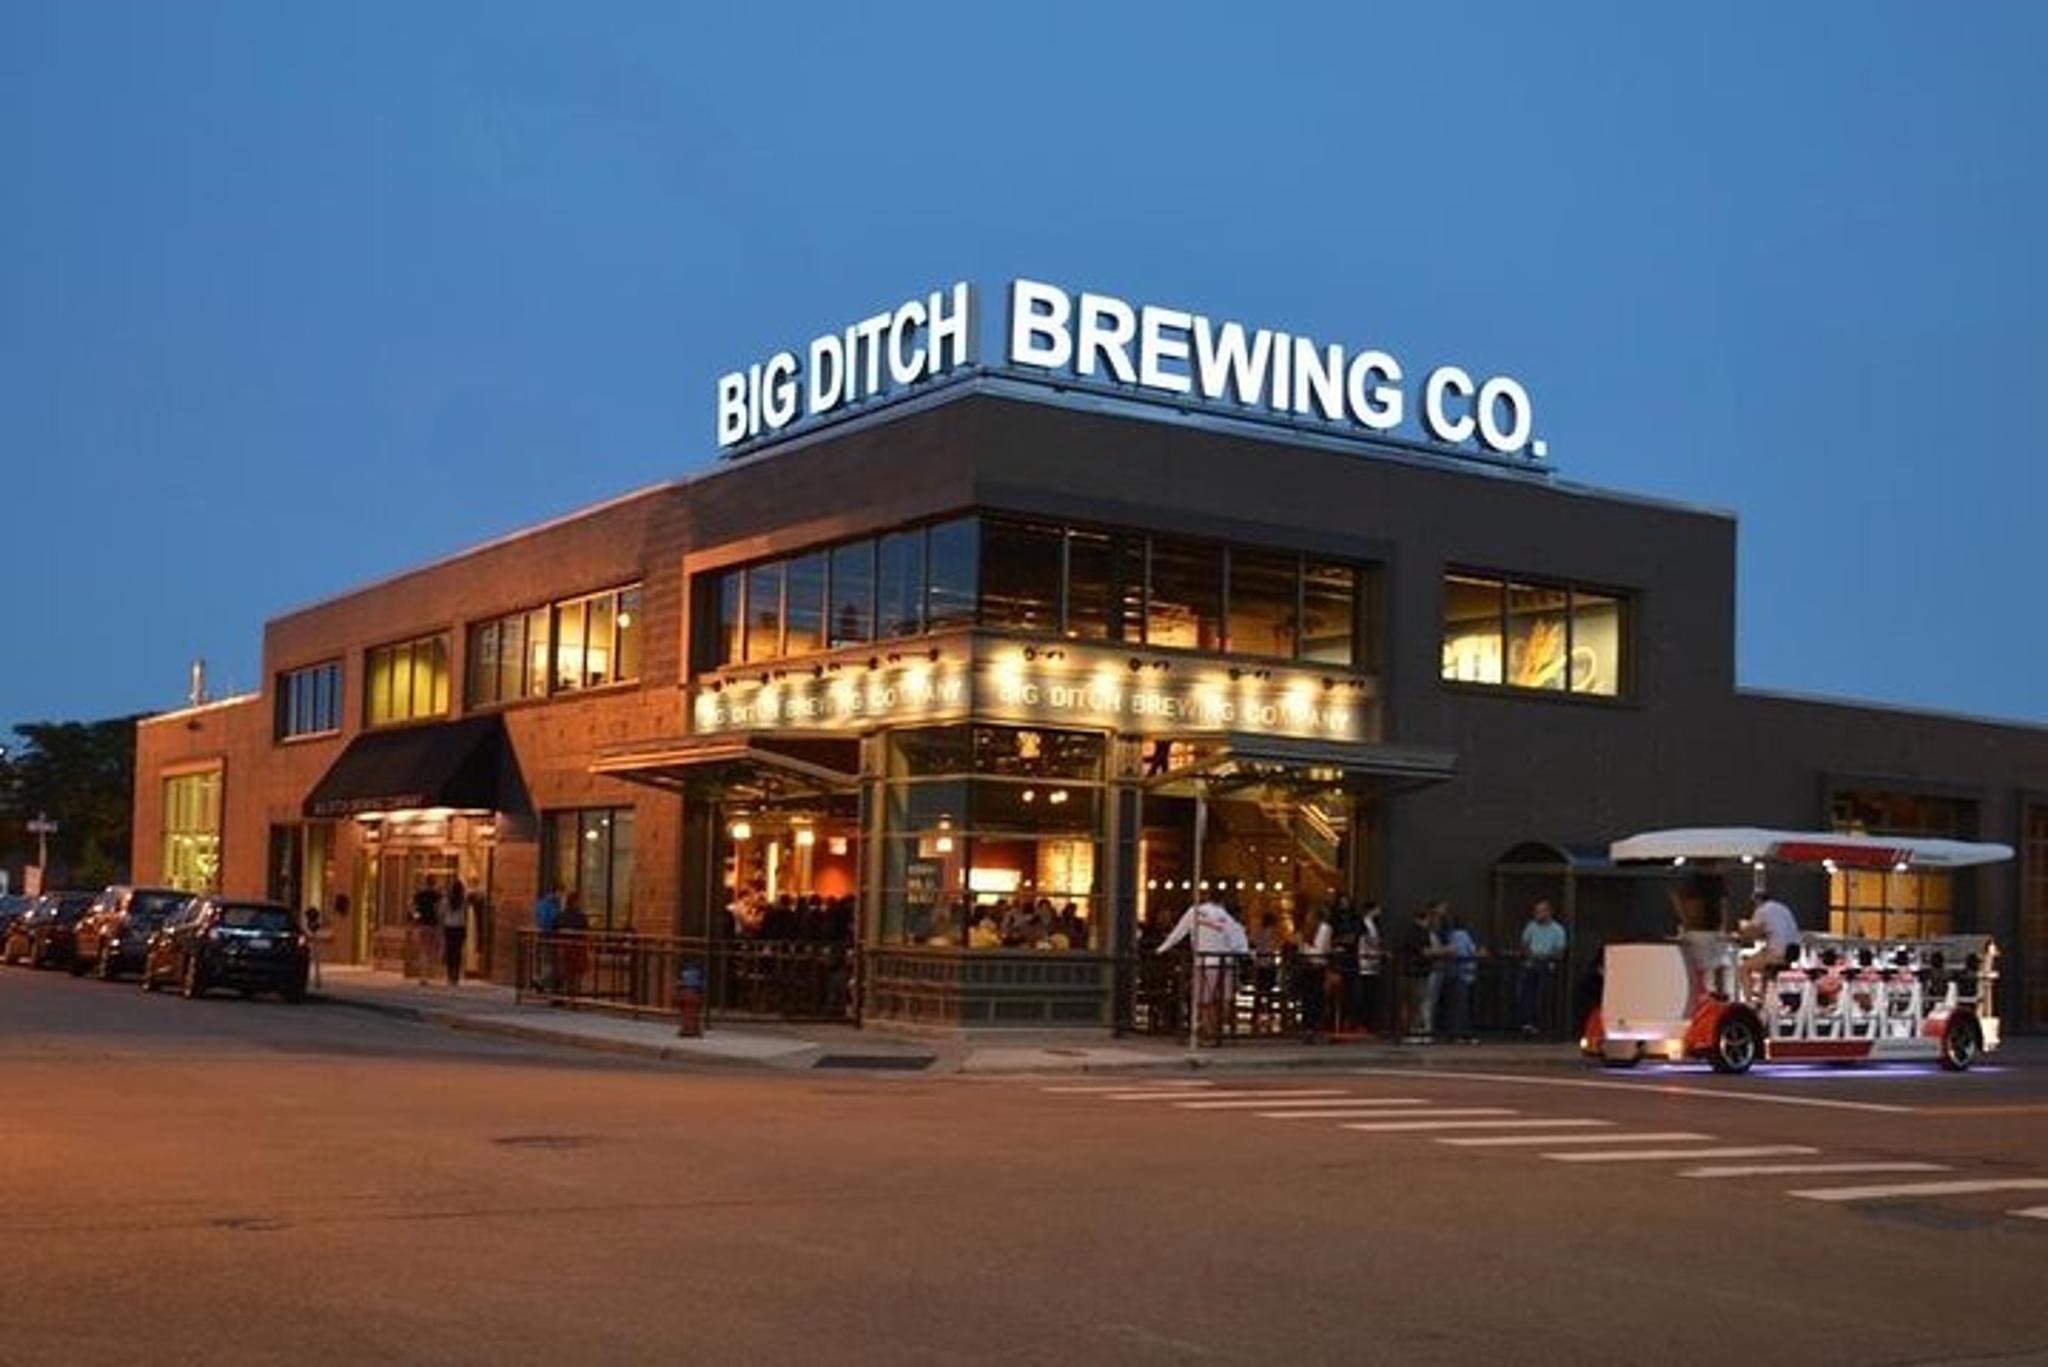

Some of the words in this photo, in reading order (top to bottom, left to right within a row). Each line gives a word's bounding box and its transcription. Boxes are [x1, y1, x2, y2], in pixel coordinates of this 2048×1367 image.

[718, 352, 798, 446] BIG
[809, 281, 968, 414] DITCH
[1011, 278, 1404, 430] BREWING
[1425, 365, 1548, 457] CO.
[1051, 686, 1121, 711] DITCH
[1132, 693, 1234, 721] BREWING
